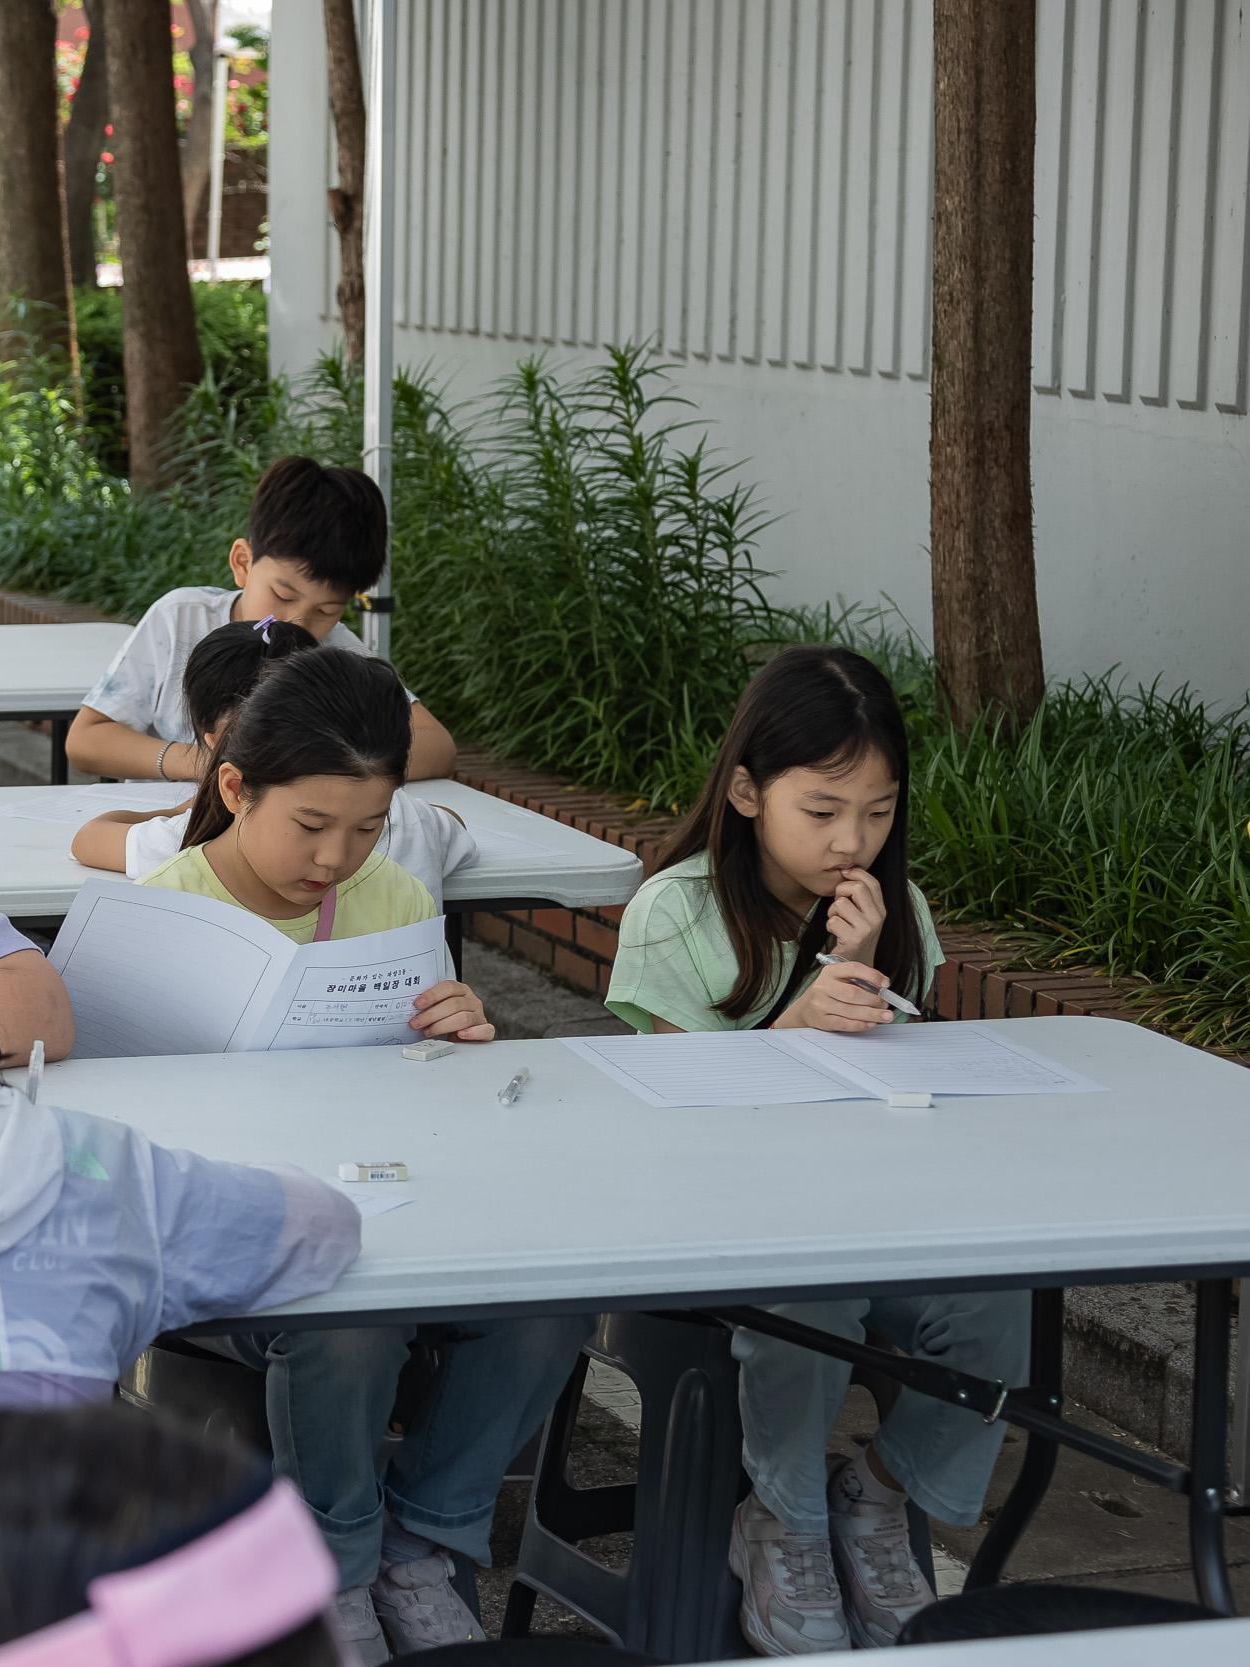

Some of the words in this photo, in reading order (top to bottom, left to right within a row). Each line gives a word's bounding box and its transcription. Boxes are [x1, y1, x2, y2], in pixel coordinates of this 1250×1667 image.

[326, 984, 367, 993] 장미마을
[373, 979, 400, 991] 백일장
[404, 975, 421, 987] 대회
